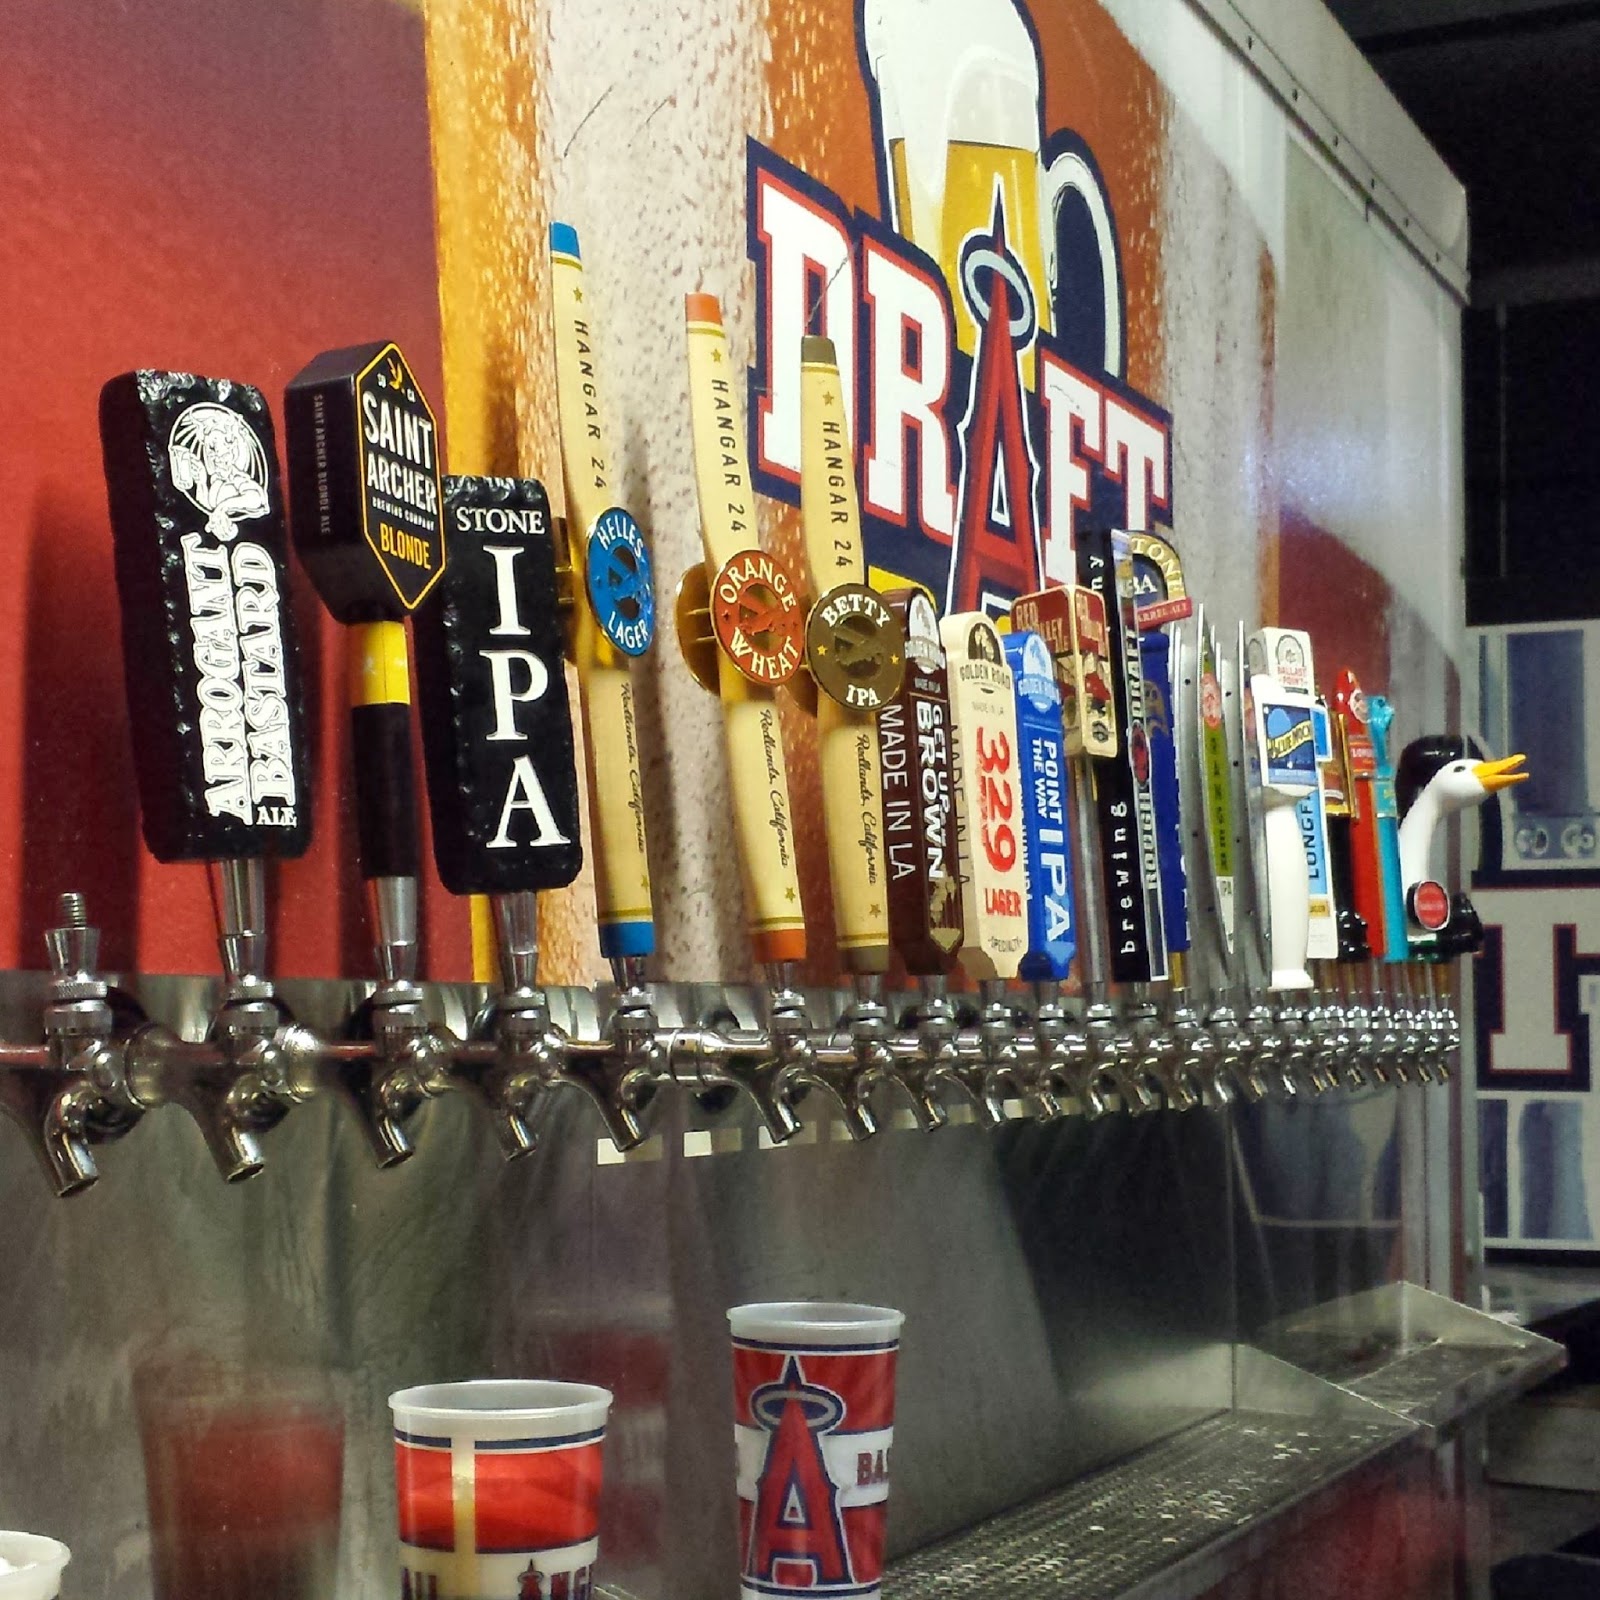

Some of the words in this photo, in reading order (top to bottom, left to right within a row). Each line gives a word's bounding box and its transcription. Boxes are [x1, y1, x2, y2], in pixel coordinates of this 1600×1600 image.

[314, 394, 325, 424] SAINT
[573, 319, 601, 441] HANGAR
[590, 456, 609, 490] 24
[750, 167, 1171, 617] DRAFT
[315, 428, 327, 469] ARCHER
[362, 390, 432, 469] SAINT
[711, 378, 742, 488] HANGAR
[317, 471, 330, 512] BLONDE
[367, 450, 438, 516] ARCHER
[822, 421, 849, 526] HANGAR
[320, 516, 331, 534] ALE
[372, 496, 403, 519] BREWING
[456, 508, 545, 535] STONE
[726, 503, 747, 534] 24
[380, 522, 432, 570] BLONDE
[596, 516, 645, 559] HELLES
[834, 540, 853, 569] 24
[720, 557, 798, 613] ORANGE
[820, 593, 891, 628] BETTY
[608, 611, 650, 649] LAGER
[729, 627, 799, 681] WHEAT
[180, 532, 253, 825] ARROGANT
[229, 541, 295, 804] BASTARD
[479, 544, 572, 850] IPA
[845, 684, 881, 707] IPA
[960, 664, 989, 682] GOLDEN
[879, 705, 908, 790] MADE
[932, 705, 949, 767] GET
[1032, 737, 1045, 772] THE
[760, 709, 777, 785] Redlands,
[769, 789, 788, 868] California
[856, 734, 870, 806] Redlands,
[914, 702, 944, 880] BROWN
[937, 769, 949, 813] UP
[1042, 740, 1063, 825] POINT
[256, 806, 297, 827] ALE
[886, 801, 912, 831] IN
[976, 726, 1017, 873] 329
[1035, 778, 1049, 818] WAY
[857, 812, 877, 885] California
[888, 843, 917, 880] LA
[1139, 792, 1158, 890] ROUGH
[985, 887, 1022, 917] LAGER
[1040, 828, 1071, 942] IPA
[1111, 802, 1137, 954] brewing
